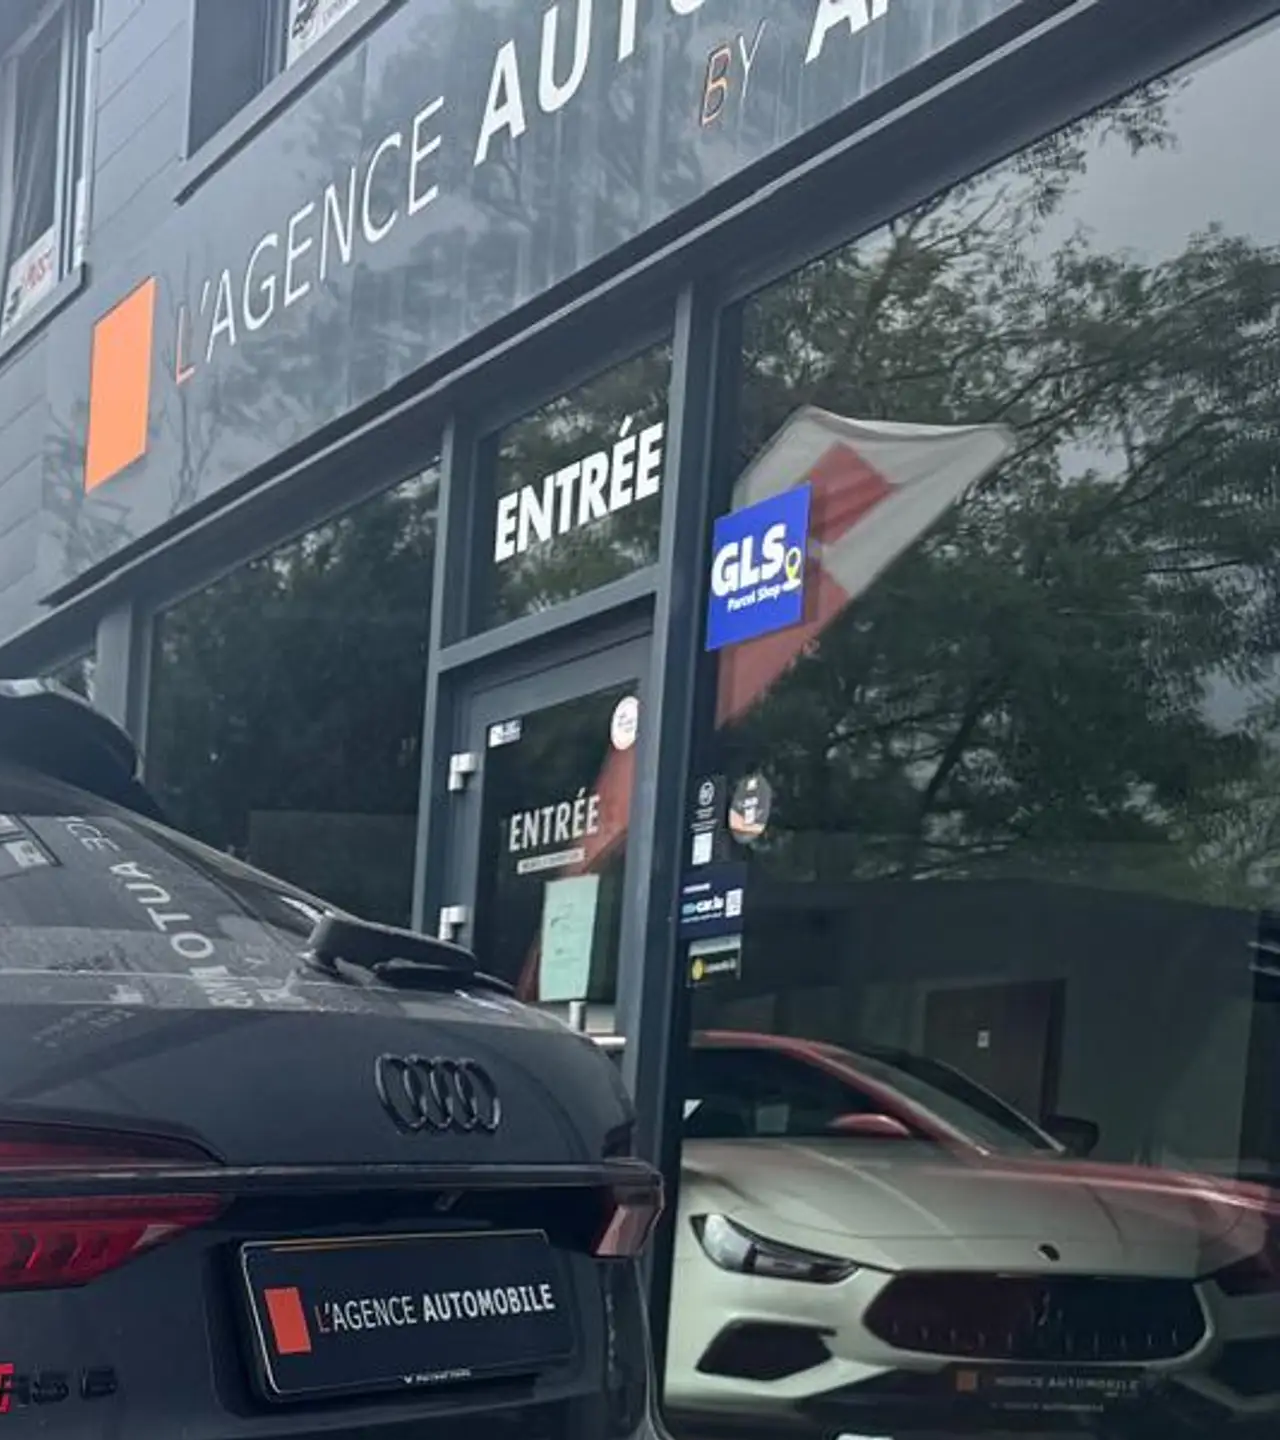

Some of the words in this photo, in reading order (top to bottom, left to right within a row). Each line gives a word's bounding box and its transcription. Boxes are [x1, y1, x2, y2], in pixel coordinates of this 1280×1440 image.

[700, 19, 767, 127] BY
[175, 96, 444, 385] L'AGENCE
[495, 417, 664, 563] ENTRÉE
[711, 523, 787, 597] GLS
[509, 787, 601, 852] ENTRÉE
[314, 1295, 418, 1333] L'AGENCE
[422, 1283, 557, 1322] AUTOMOBILE
